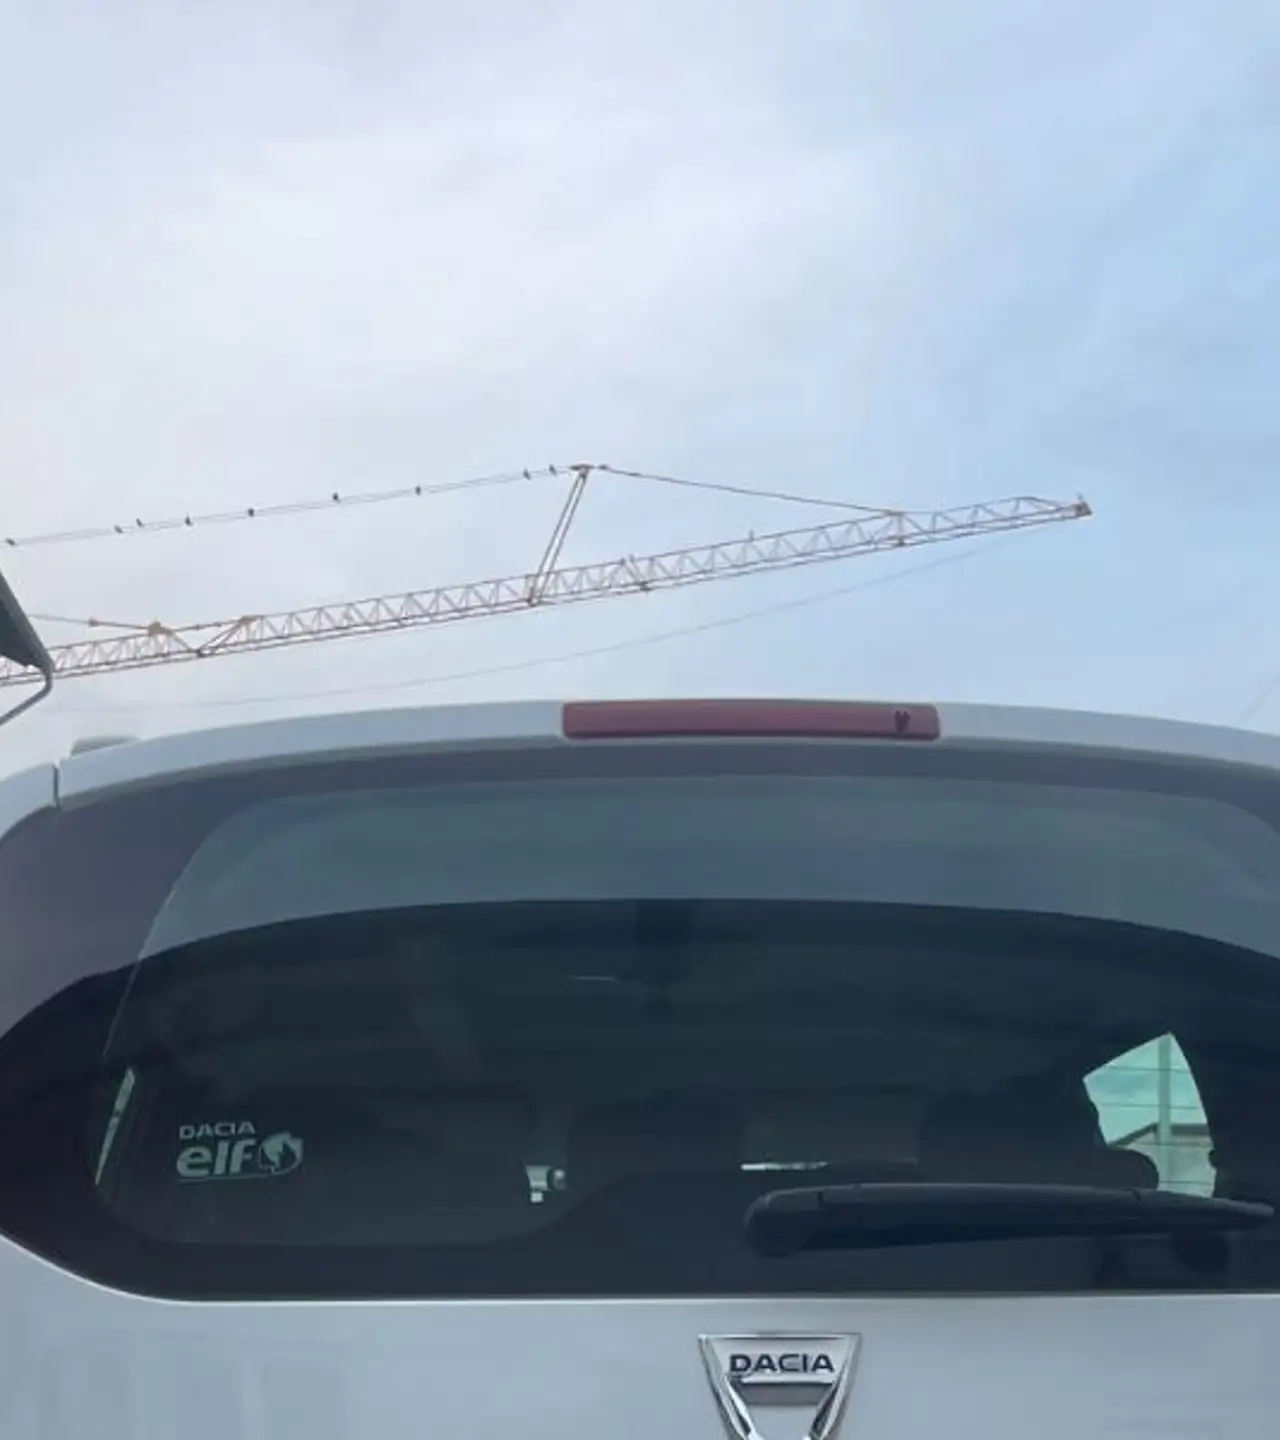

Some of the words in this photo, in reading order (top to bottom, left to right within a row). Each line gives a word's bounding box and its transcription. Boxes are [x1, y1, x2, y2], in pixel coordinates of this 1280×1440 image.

[178, 1120, 257, 1141] DACIA
[176, 1138, 257, 1178] elf
[729, 1352, 835, 1374] DACIA
